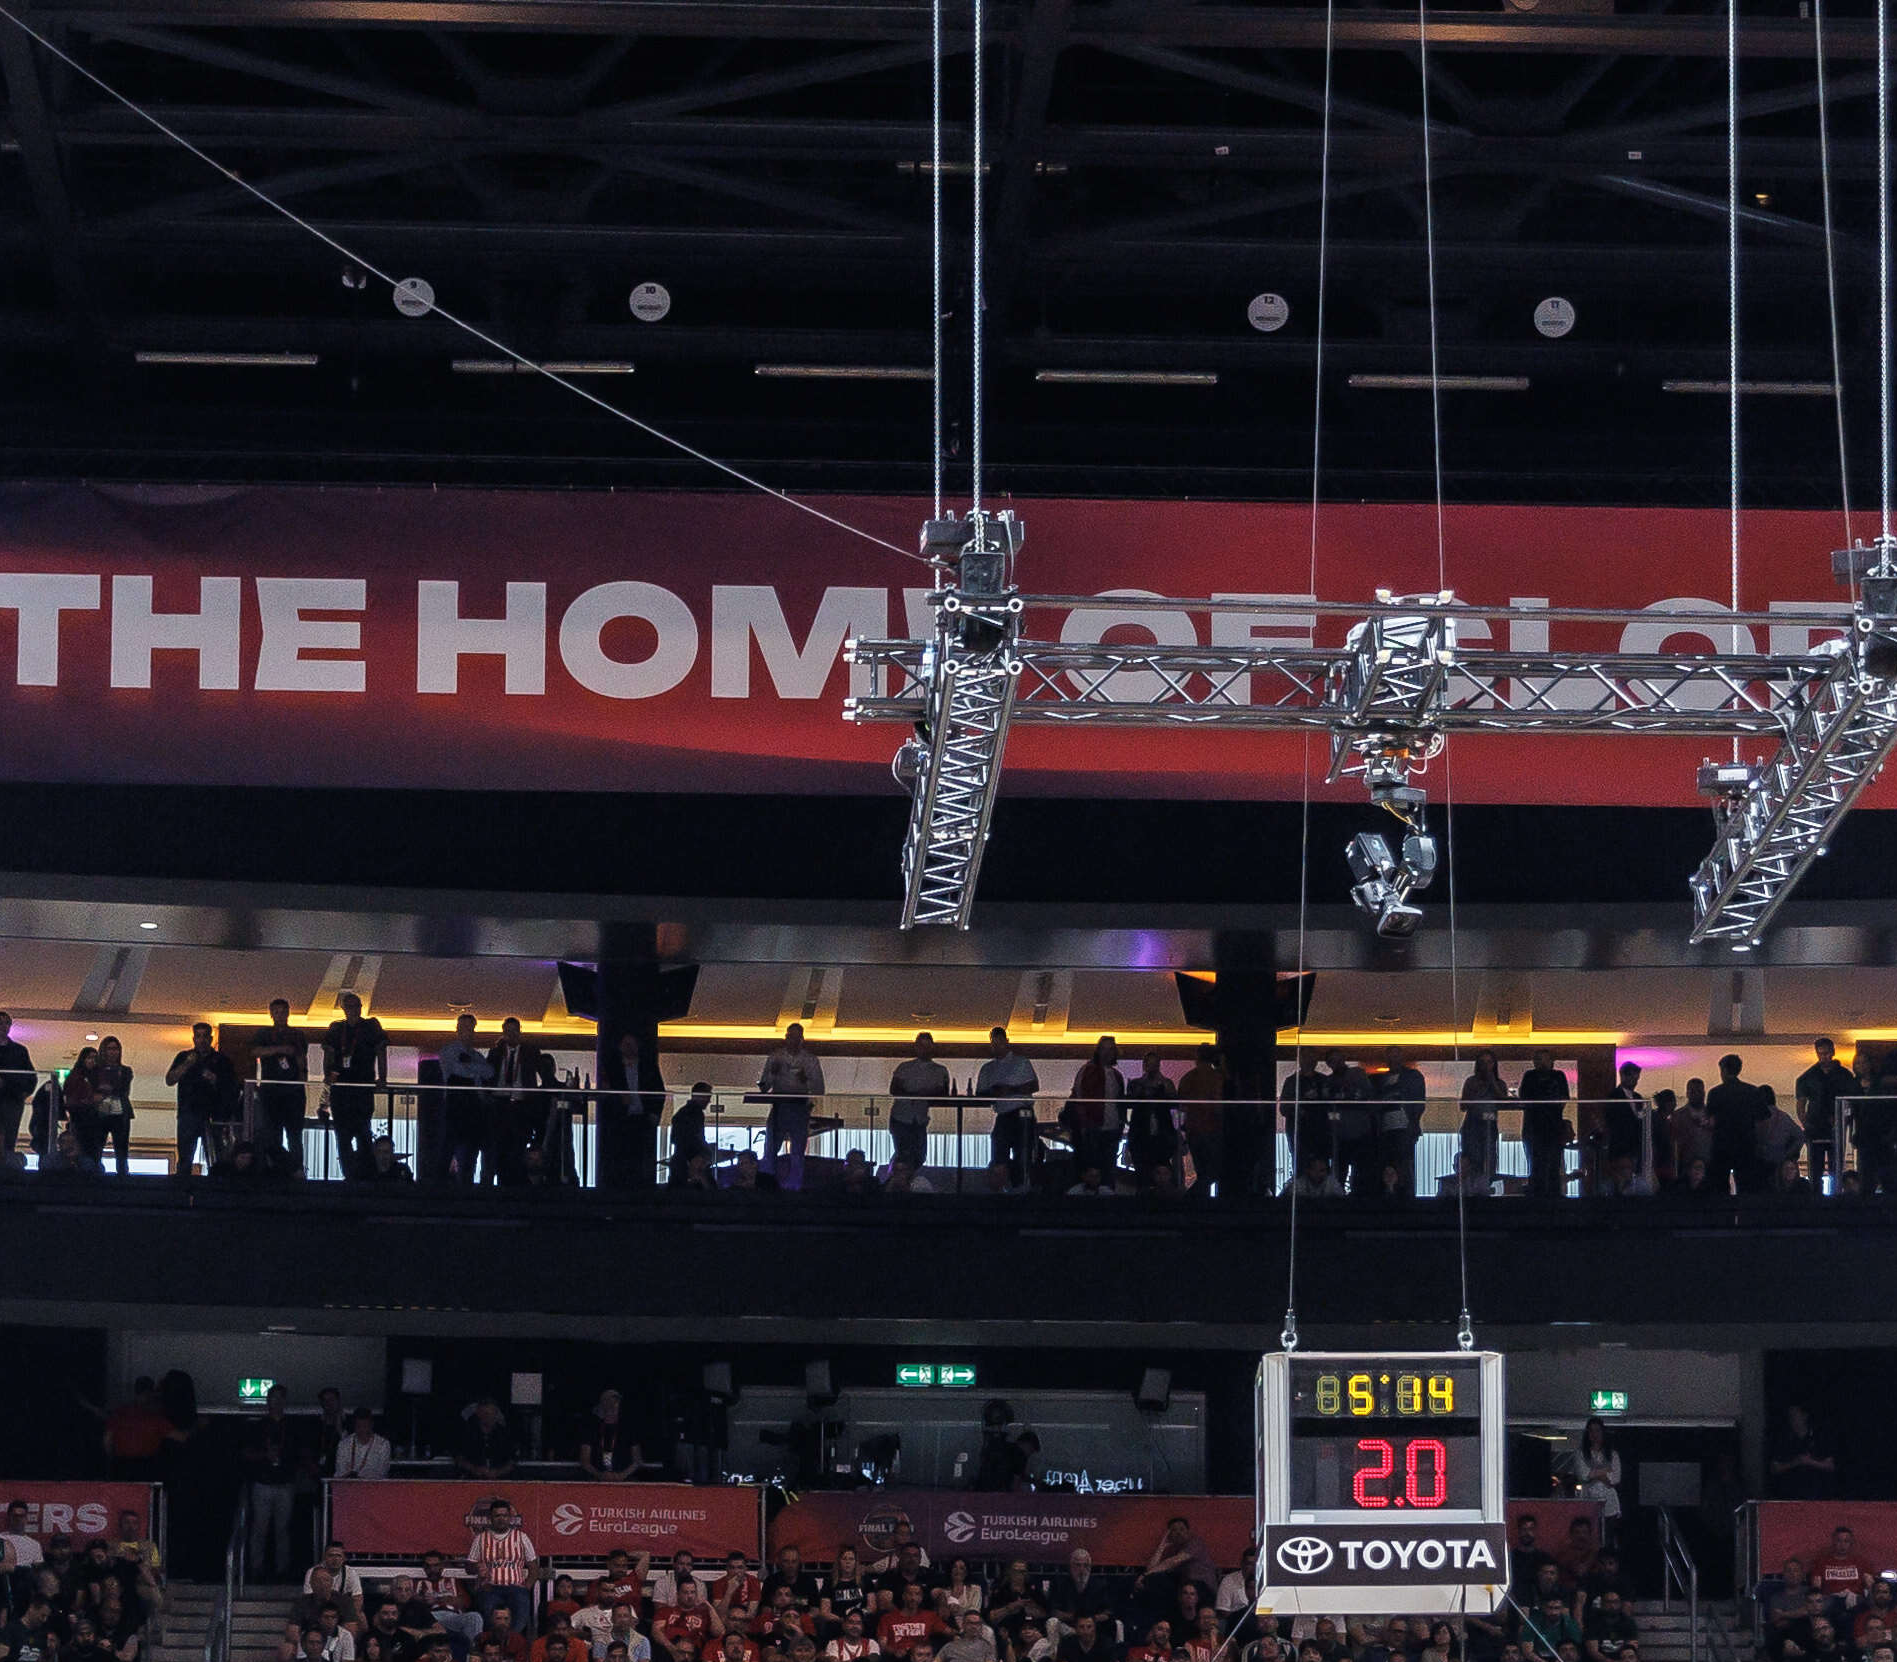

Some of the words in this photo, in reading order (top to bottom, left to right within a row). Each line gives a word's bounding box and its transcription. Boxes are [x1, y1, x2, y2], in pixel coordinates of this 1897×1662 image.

[416, 579, 942, 701] HOM
[1060, 587, 1316, 711] OF
[1348, 1374, 1453, 1416] 5:14
[1353, 1438, 1447, 1509] 2.0
[589, 1507, 645, 1522] TURKISH
[648, 1507, 708, 1523] AIRLINES
[980, 1514, 1034, 1530] TURKISH
[1038, 1515, 1099, 1530] AIRLINES
[589, 1521, 679, 1538] EuroLeague
[980, 1528, 1070, 1545] EuroLeague
[1339, 1539, 1497, 1570] TOYOTA
